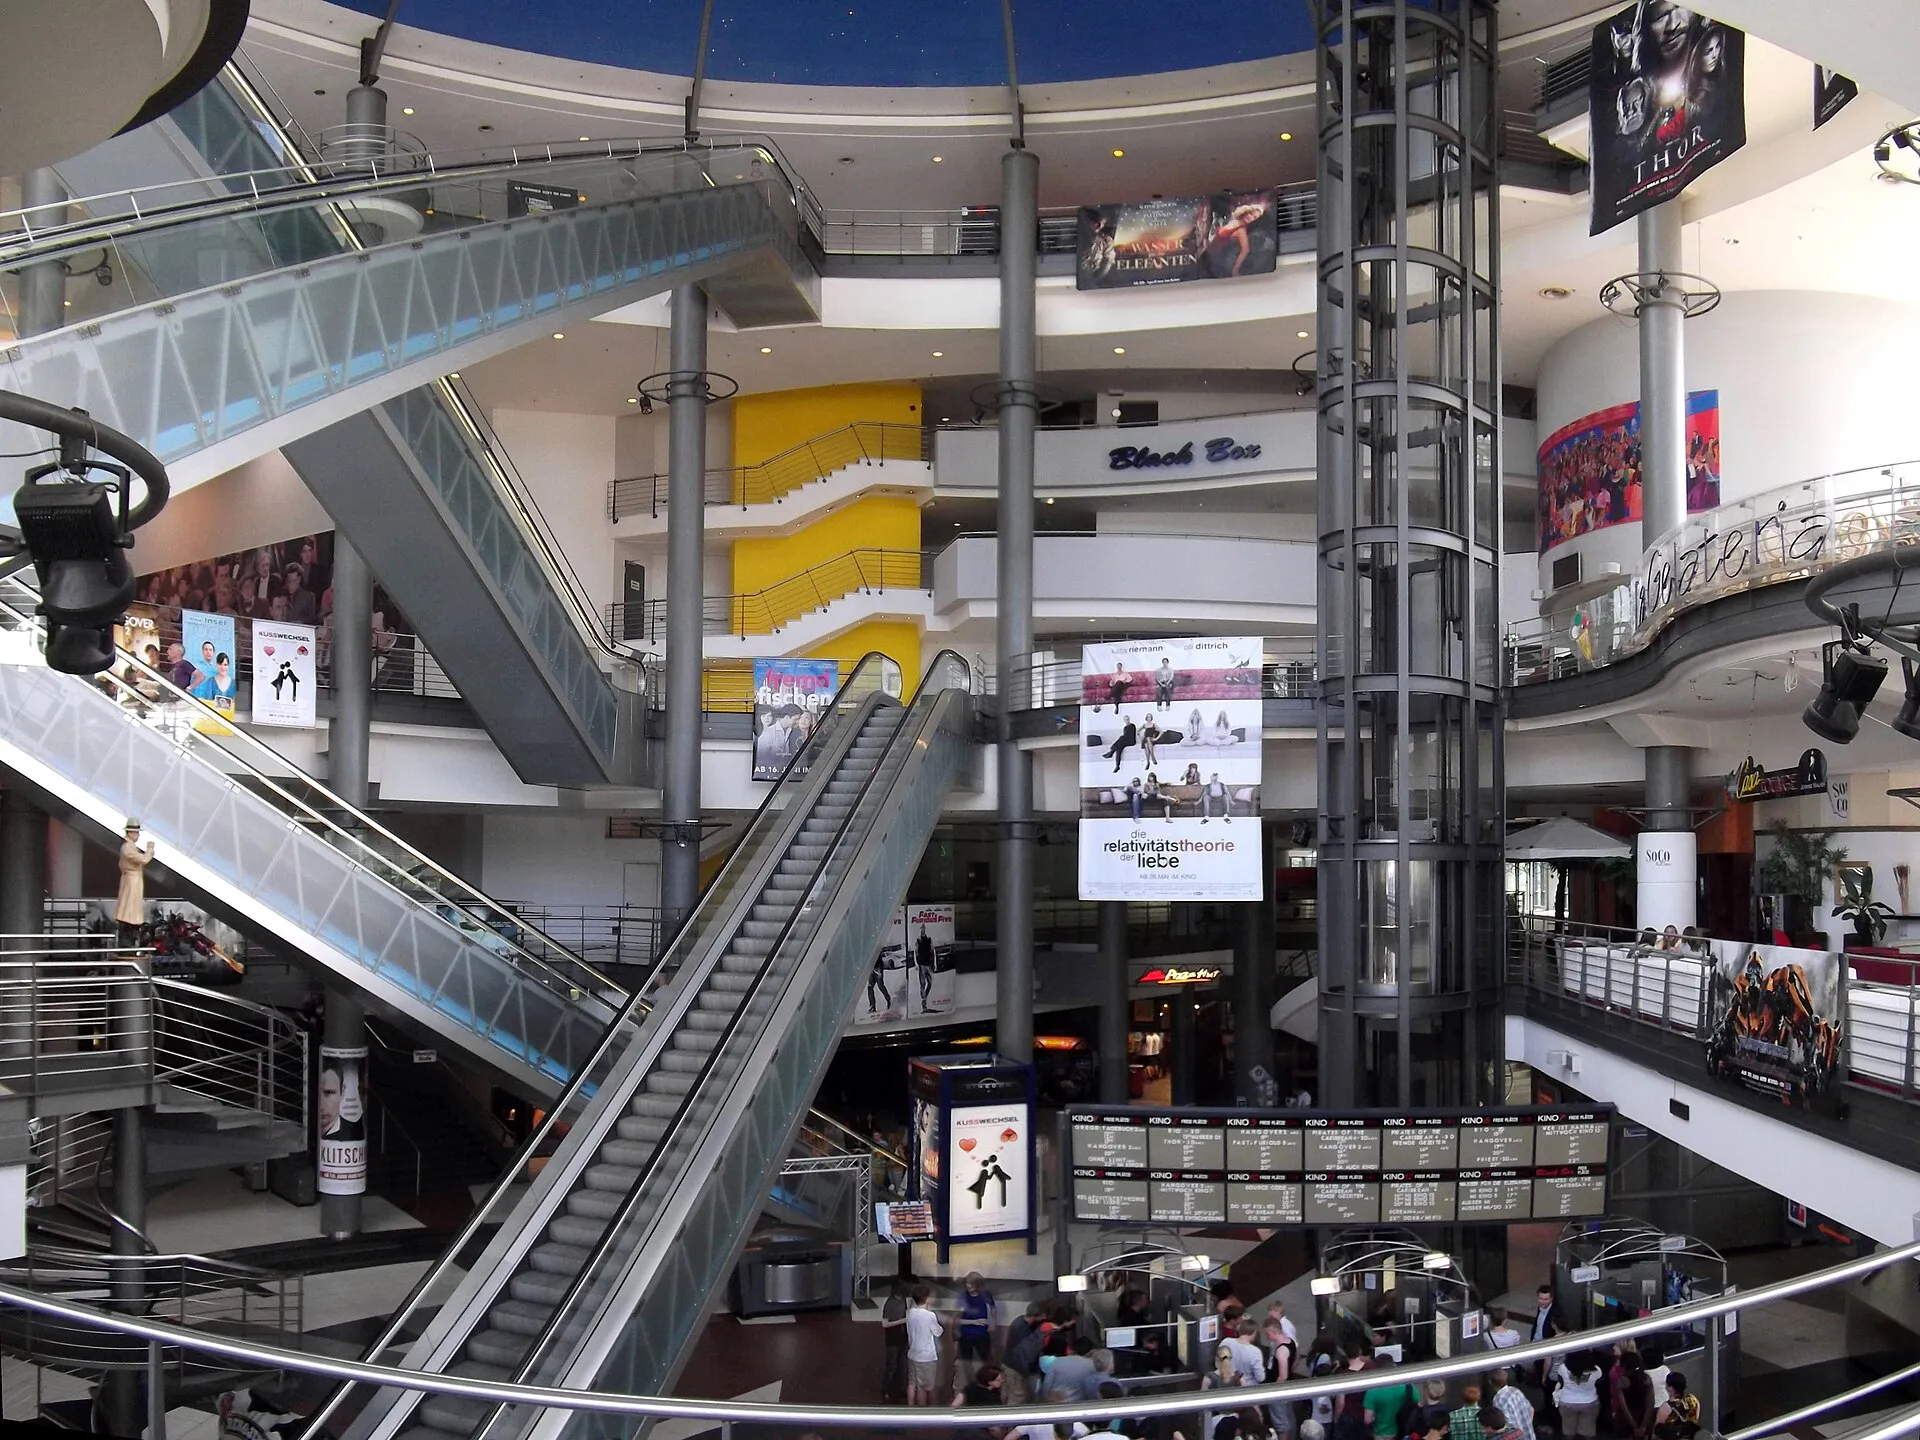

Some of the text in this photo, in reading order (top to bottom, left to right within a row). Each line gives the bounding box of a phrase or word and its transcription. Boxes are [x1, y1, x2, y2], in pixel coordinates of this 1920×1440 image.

[1633, 126, 1704, 184] THOR
[1132, 239, 1184, 253] WASSER
[1116, 254, 1197, 270] ELEFANTEN
[1109, 437, 1262, 470] Black Box
[1647, 500, 1832, 612] Gelateria
[259, 631, 310, 643] KUSSWECHSEL
[1129, 645, 1164, 653] riemann
[1195, 642, 1228, 650] dittrich
[765, 667, 831, 692] fremd
[756, 684, 833, 708] fischen
[1130, 829, 1147, 839] die
[1103, 838, 1235, 852] relativitätstheorie
[1120, 854, 1135, 862] der
[1137, 853, 1180, 868] liebe
[1164, 968, 1220, 981] Pizza Hut
[956, 1116, 1020, 1126] KUSSWECHSEL
[1072, 1115, 1094, 1123] KINO
[1149, 1117, 1172, 1125] KINO
[1305, 1119, 1328, 1127] KINO
[1383, 1118, 1406, 1126] KINO
[1461, 1116, 1484, 1125] KINO
[1537, 1114, 1559, 1122] KINO
[1073, 1169, 1095, 1177] KINO
[1227, 1173, 1250, 1181] KINO
[1459, 1171, 1482, 1179] KINO
